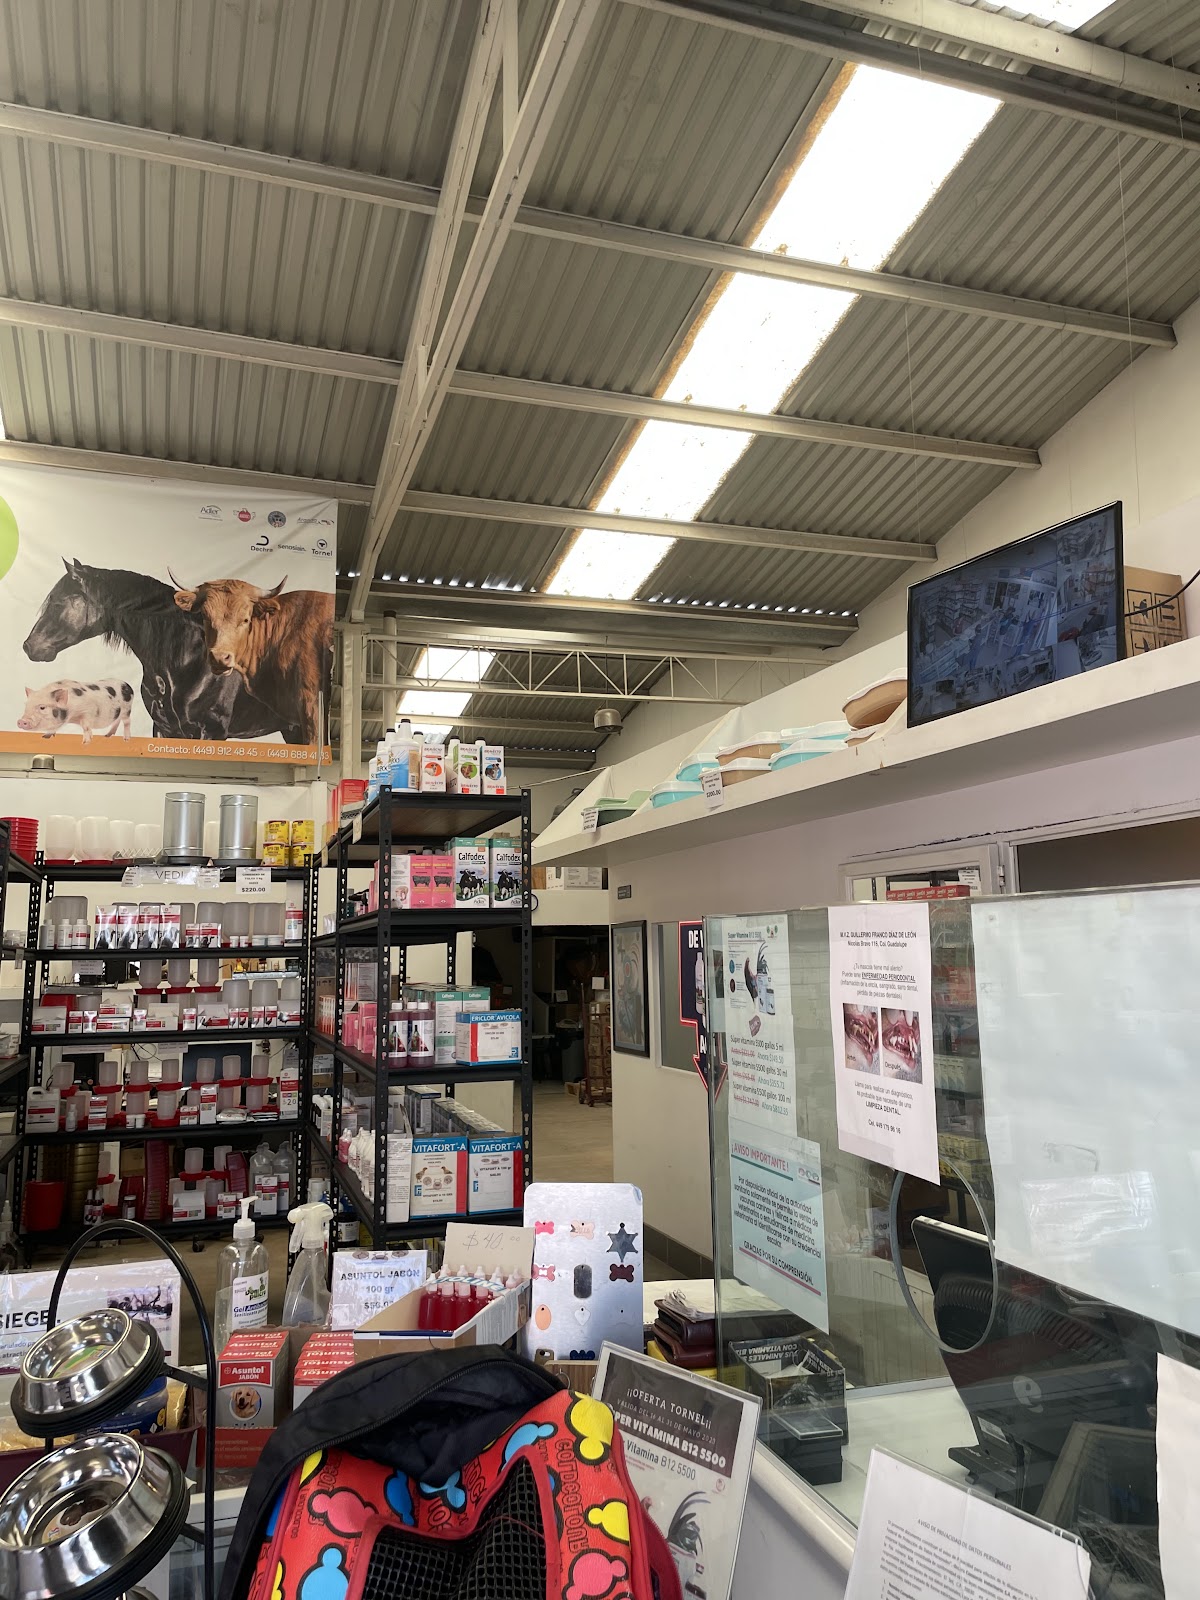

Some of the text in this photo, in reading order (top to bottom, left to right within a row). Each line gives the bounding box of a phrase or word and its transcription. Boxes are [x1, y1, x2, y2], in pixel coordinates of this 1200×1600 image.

[311, 548, 333, 557] Tornel
[147, 744, 190, 754] Contacto:
[192, 745, 215, 755] (449)
[217, 746, 232, 756] 912
[233, 747, 245, 756] 48
[247, 748, 258, 757] 45
[267, 748, 288, 758] (449)
[290, 750, 307, 759] 688
[309, 751, 317, 760] 41
[458, 853, 484, 861] Calfodex
[496, 853, 521, 862] Calfodex
[688, 930, 699, 948] DE
[862, 972, 888, 980] ENFERMEDAD
[888, 974, 915, 982] PERIODONTAL
[765, 1042, 776, 1050] gallos
[766, 1066, 776, 1075] gallos
[885, 1061, 901, 1070] Después
[767, 1090, 777, 1100] gallos
[865, 1101, 883, 1110] LIMPIEZA
[731, 1143, 750, 1157] ¡AVISO
[745, 1177, 766, 1194] disposición
[767, 1186, 779, 1198] oficial
[778, 1191, 785, 1201] de
[790, 1198, 812, 1214] autoridad
[739, 1195, 756, 1208] vacunas
[756, 1202, 772, 1214] caninas
[775, 1209, 789, 1224] felinas
[793, 1218, 812, 1235] médicos
[750, 1190, 771, 1206] solamente
[776, 1202, 793, 1216] permite
[799, 1211, 811, 1224] venta
[812, 1217, 818, 1227] de
[738, 1202, 759, 1219] veterinarios
[763, 1215, 787, 1232] estudiantes
[787, 1225, 794, 1235] de
[794, 1229, 815, 1246] medicina
[758, 1221, 782, 1239] identificarse
[783, 1234, 791, 1244] con
[797, 1241, 822, 1259] credencial
[744, 1241, 814, 1286] GRACIAS POR SU COMPRENSIÓN.
[341, 1268, 420, 1281] ASUNTOL JABÓN
[366, 1285, 394, 1294] 100 gr
[364, 1300, 394, 1310] $56.0
[748, 1345, 781, 1354] VITAMINA
[749, 1352, 784, 1361] ANIMALES
[617, 1398, 637, 1412] VALIDA
[638, 1407, 649, 1417] DEL
[657, 1415, 665, 1424] AL
[666, 1419, 672, 1427] 31
[673, 1422, 681, 1430] DE
[683, 1425, 700, 1438] MAYO
[633, 1419, 680, 1449] VITAMINA
[681, 1440, 698, 1457] B12
[700, 1450, 726, 1468] 5500
[627, 1440, 659, 1464] Vitamina
[661, 1456, 676, 1472] B12
[677, 1464, 696, 1481] 5500
[917, 1518, 930, 1530] AVISO
[931, 1524, 936, 1532] DE
[961, 1540, 968, 1549] DE
[968, 1544, 983, 1557] DATOS
[983, 1551, 1012, 1571] PERSONALES
